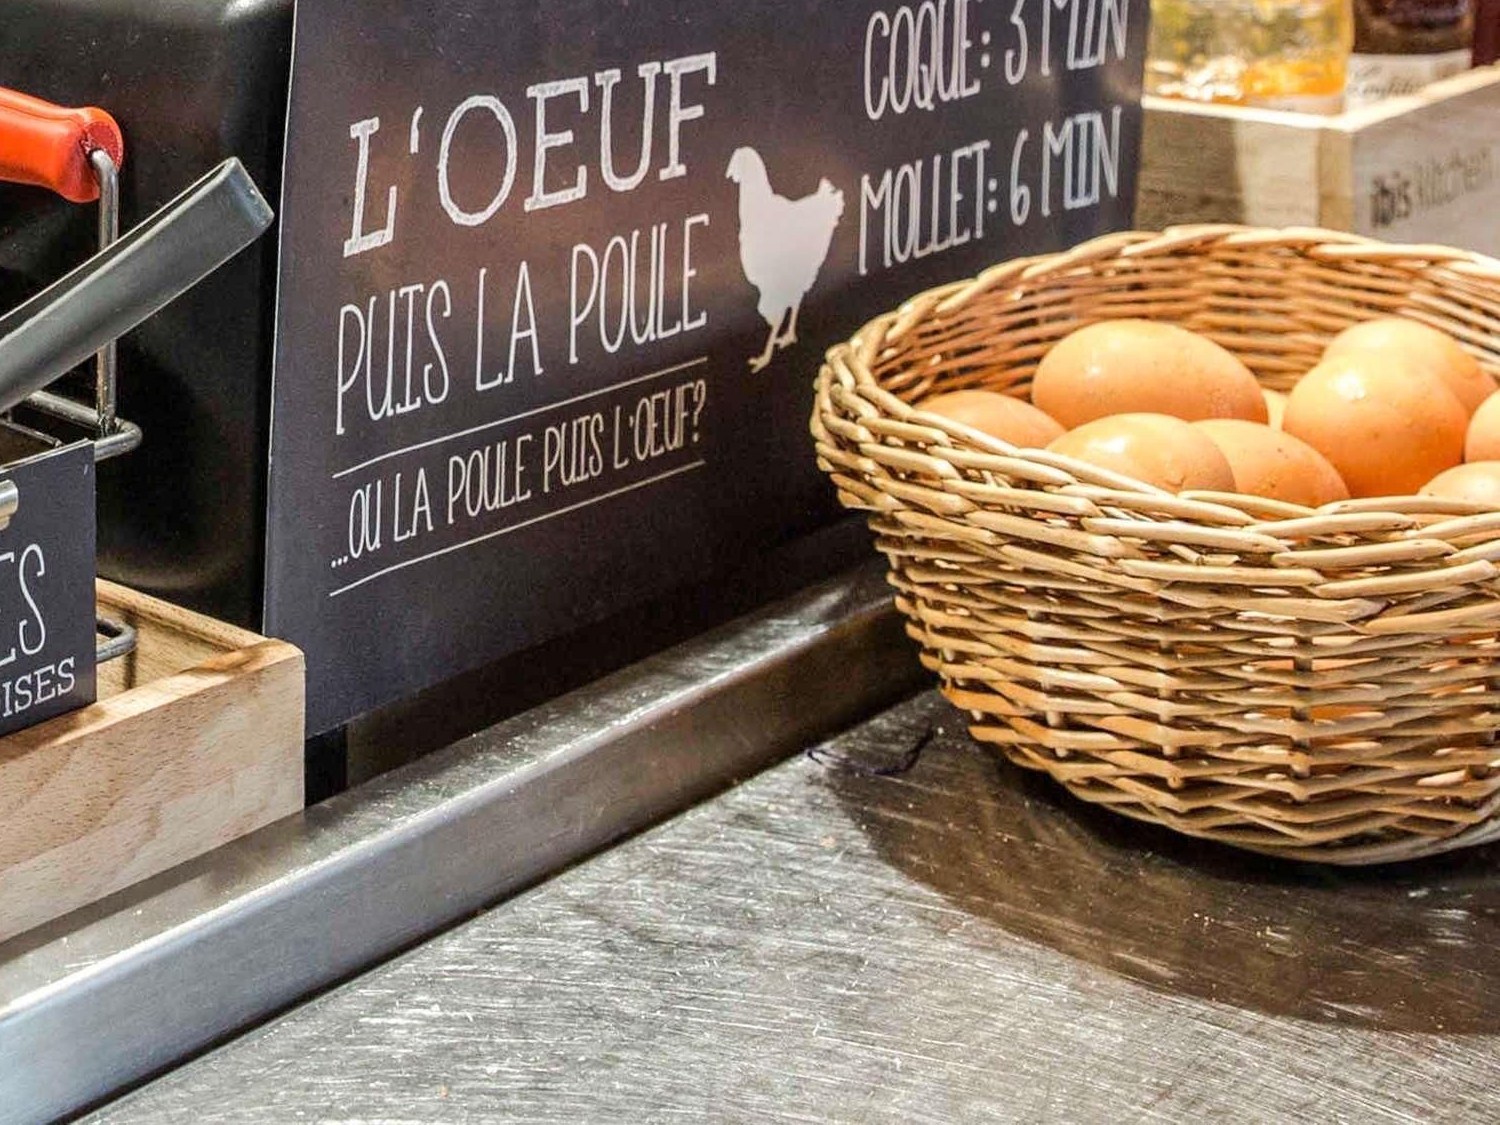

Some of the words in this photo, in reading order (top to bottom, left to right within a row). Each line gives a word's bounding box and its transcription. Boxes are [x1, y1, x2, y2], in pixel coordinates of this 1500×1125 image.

[343, 52, 717, 257] L'OEUF
[858, 139, 998, 275] MOLLET:
[1009, 129, 1028, 226] 6
[1042, 106, 1121, 218] MIN
[335, 280, 451, 435] PUIS
[476, 261, 543, 390] LA
[570, 214, 709, 364] POULE
[394, 468, 433, 542] LA
[447, 433, 531, 525] POULE
[542, 413, 604, 492] PUIS
[613, 379, 707, 474] L'OEUF?
